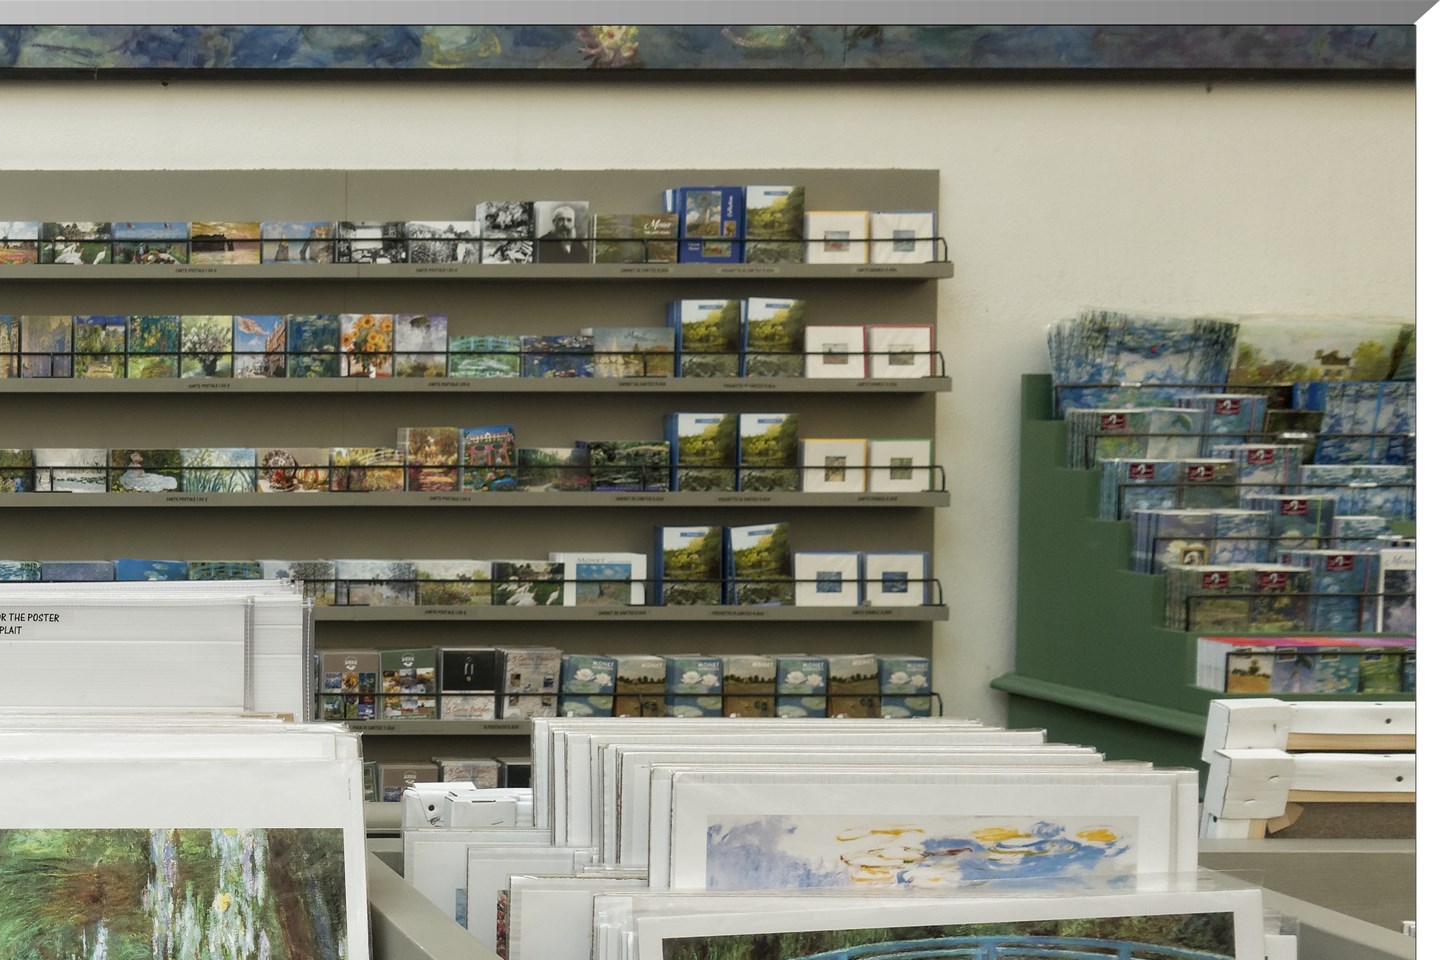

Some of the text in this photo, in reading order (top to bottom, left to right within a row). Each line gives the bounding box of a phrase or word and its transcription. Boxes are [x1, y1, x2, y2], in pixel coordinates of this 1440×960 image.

[9, 613, 26, 622] THE
[27, 613, 60, 623] POSTER
[0, 625, 22, 635] PLAIT
